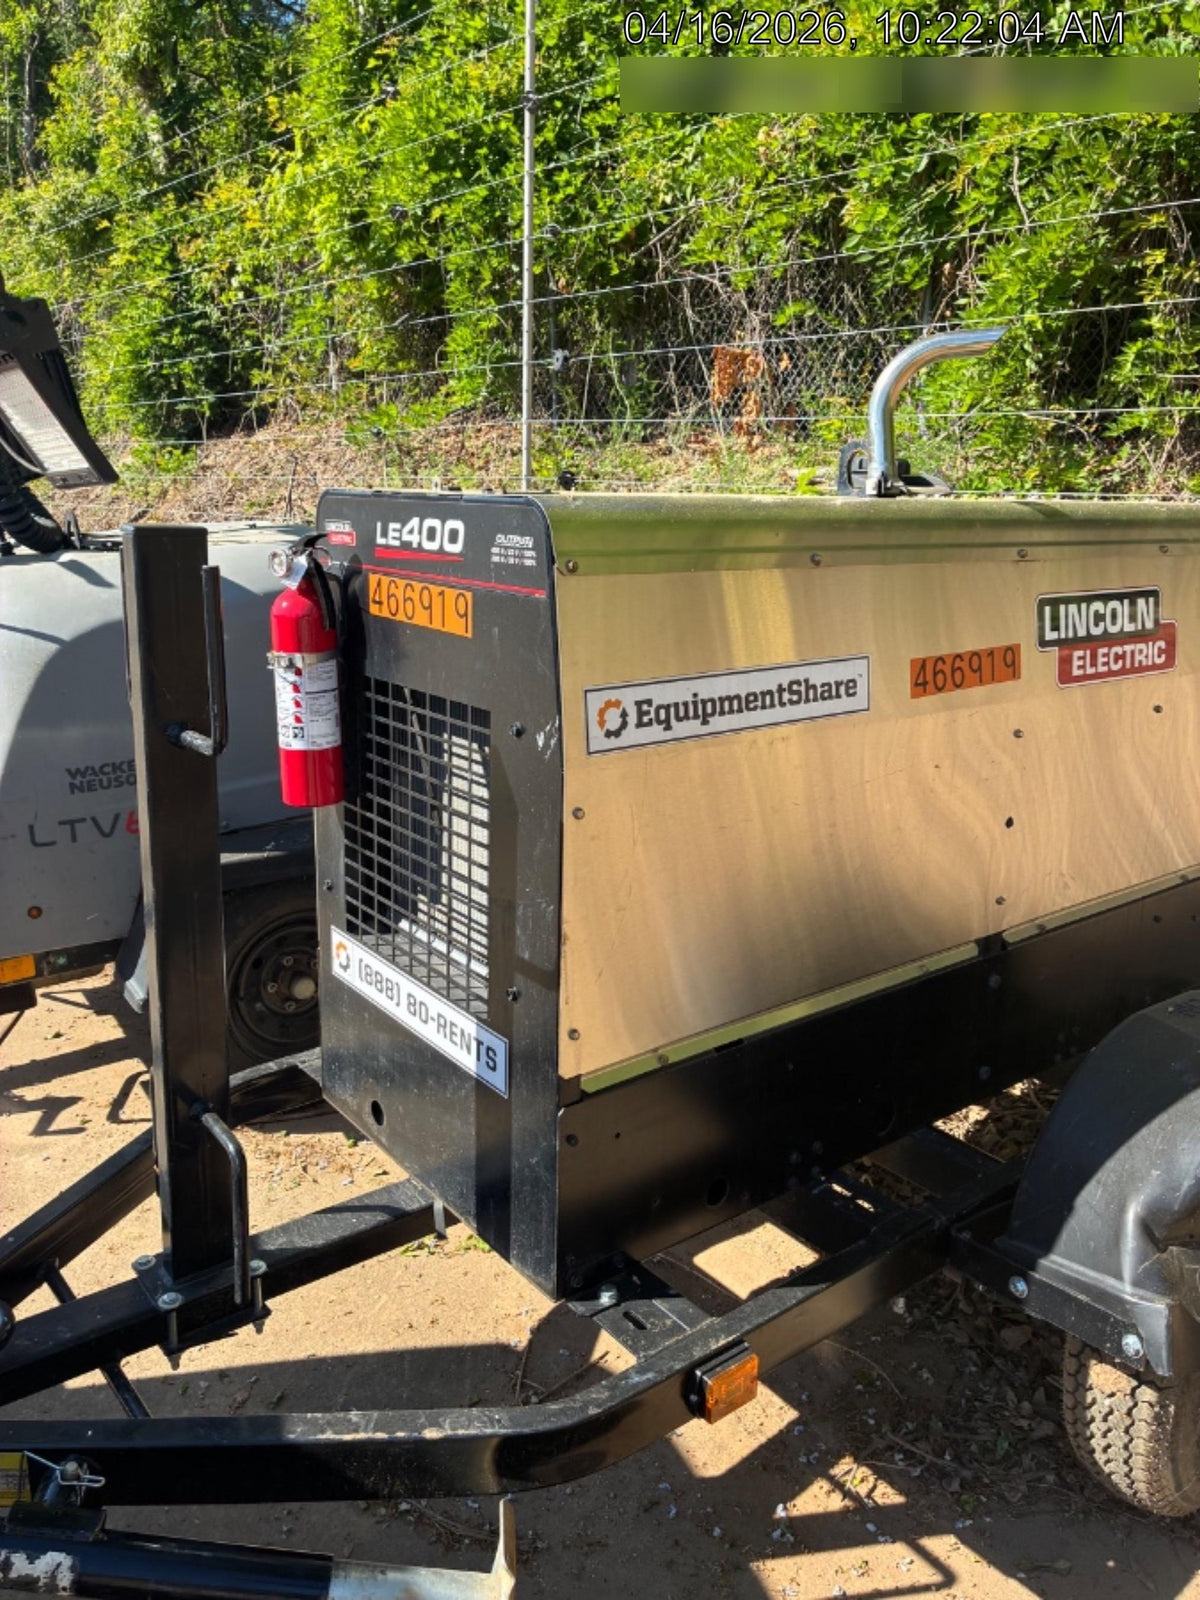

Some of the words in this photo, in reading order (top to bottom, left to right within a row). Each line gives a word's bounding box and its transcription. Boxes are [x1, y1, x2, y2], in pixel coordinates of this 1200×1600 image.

[376, 516, 465, 553] LE400
[371, 577, 469, 634] 466919
[1043, 597, 1156, 641] LINCOLN
[914, 646, 1016, 694] 466919
[1072, 640, 1167, 676] ELECTRIC
[634, 678, 858, 731] EquipmentShare
[65, 759, 136, 781] WACKE
[68, 773, 137, 795] NEUSO
[358, 957, 401, 1008] (888)
[406, 992, 498, 1073] 80-RENTS
